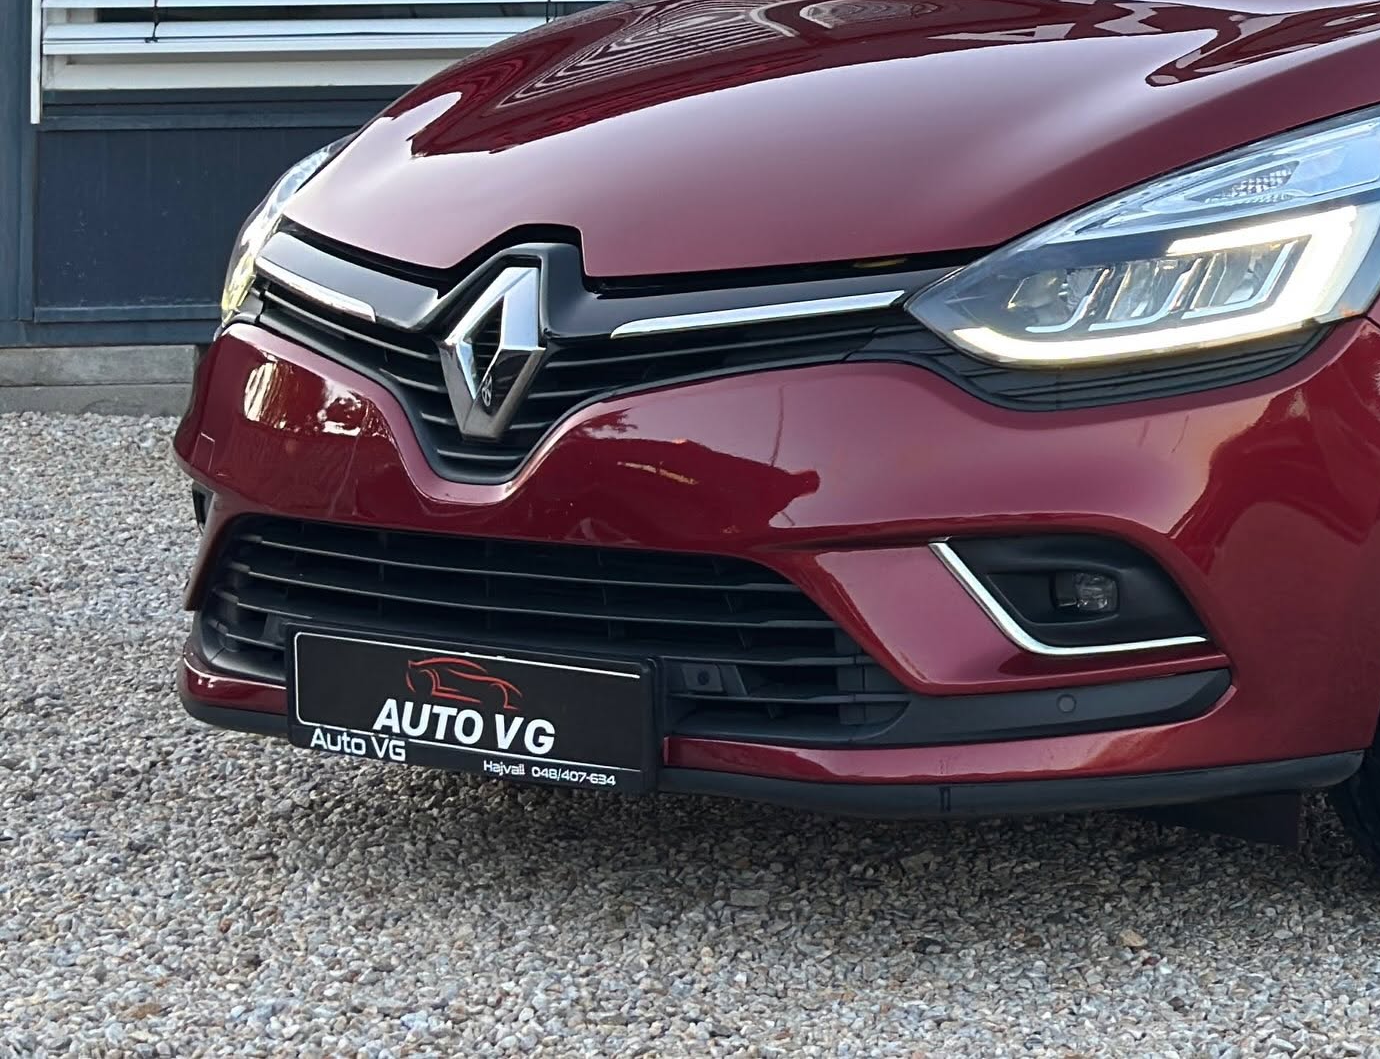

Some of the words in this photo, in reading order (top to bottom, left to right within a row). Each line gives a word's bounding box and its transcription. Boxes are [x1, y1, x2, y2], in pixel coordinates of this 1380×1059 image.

[373, 698, 484, 745] AUTO
[495, 714, 556, 755] VG
[310, 727, 366, 756] Auto
[371, 735, 406, 762] VG
[531, 766, 616, 786] 048/407-634
